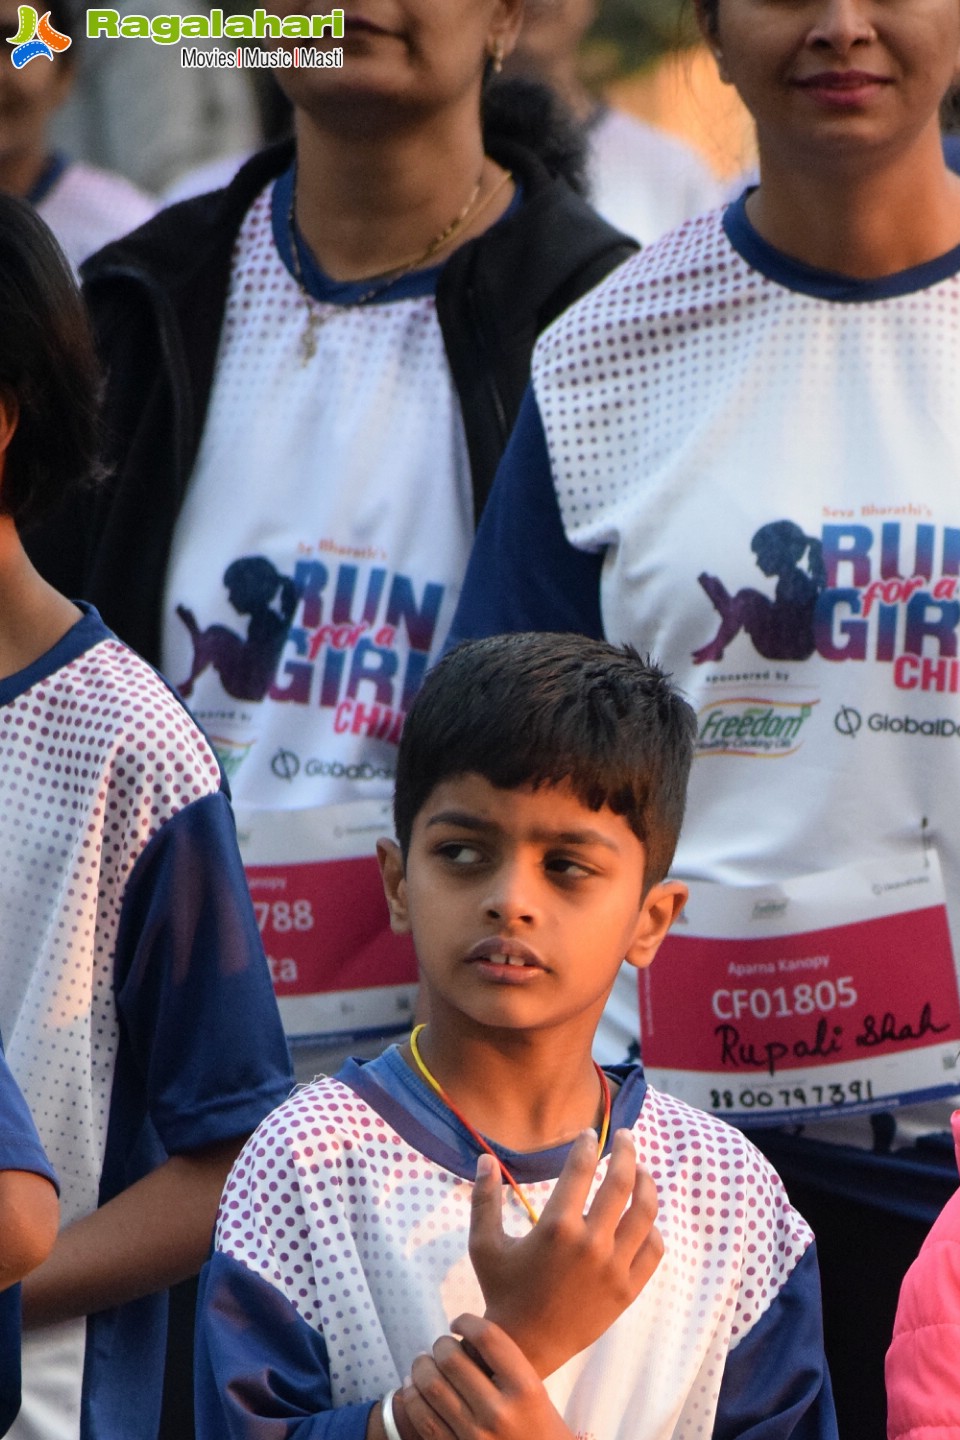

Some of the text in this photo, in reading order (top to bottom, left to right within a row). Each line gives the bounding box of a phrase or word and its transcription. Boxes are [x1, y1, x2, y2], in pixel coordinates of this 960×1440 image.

[860, 576, 958, 619] for a
[307, 621, 396, 662] for a
[699, 707, 804, 740] Freedom
[728, 954, 831, 979] Aparna Kanopy
[711, 976, 858, 1020] CF01805
